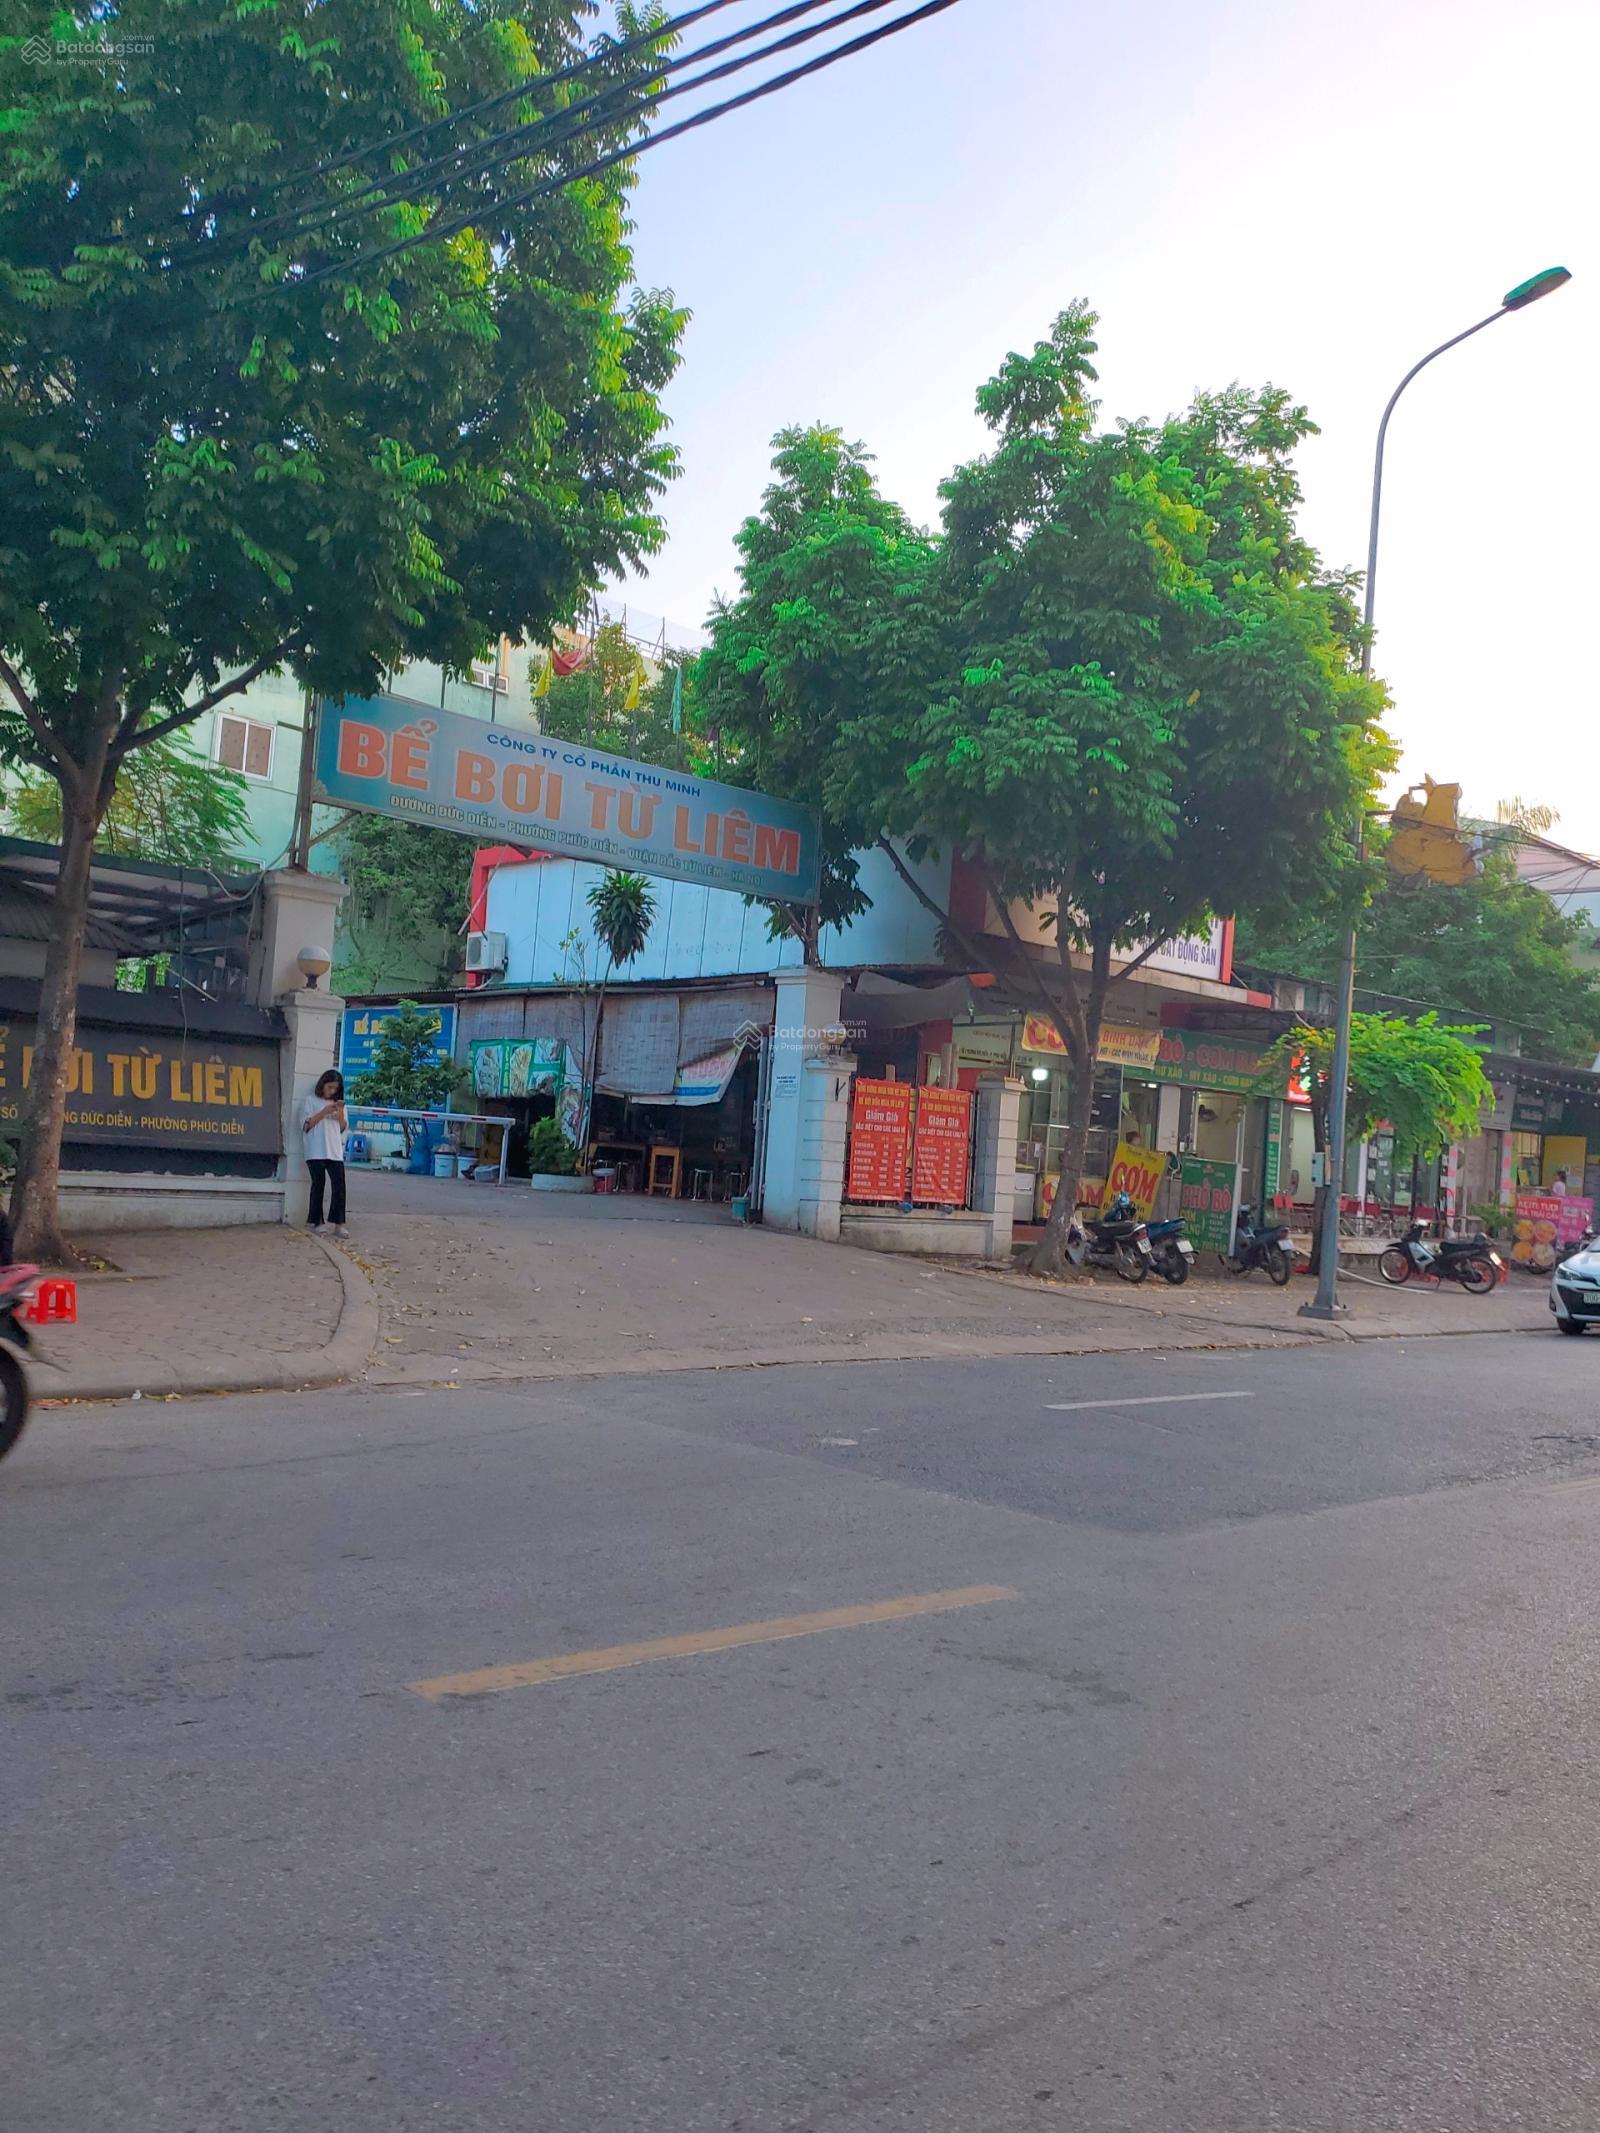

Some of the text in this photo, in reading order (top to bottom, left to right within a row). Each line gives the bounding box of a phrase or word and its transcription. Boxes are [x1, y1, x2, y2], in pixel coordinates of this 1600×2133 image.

[487, 733, 536, 754] CÔNG
[541, 747, 558, 760] TY
[562, 751, 586, 767] CỔ
[635, 772, 661, 787] THU
[665, 780, 701, 797] MINH
[339, 718, 800, 875] BỂ BƠI TỪ LIÊM
[390, 795, 436, 816] ĐƯỜNG
[107, 1046, 162, 1099] TỪ
[170, 1055, 264, 1108] LIÊM
[80, 1109, 105, 1126] ĐỨC
[141, 1113, 188, 1132] PHƯỜNG
[190, 1118, 219, 1133] PHÚC
